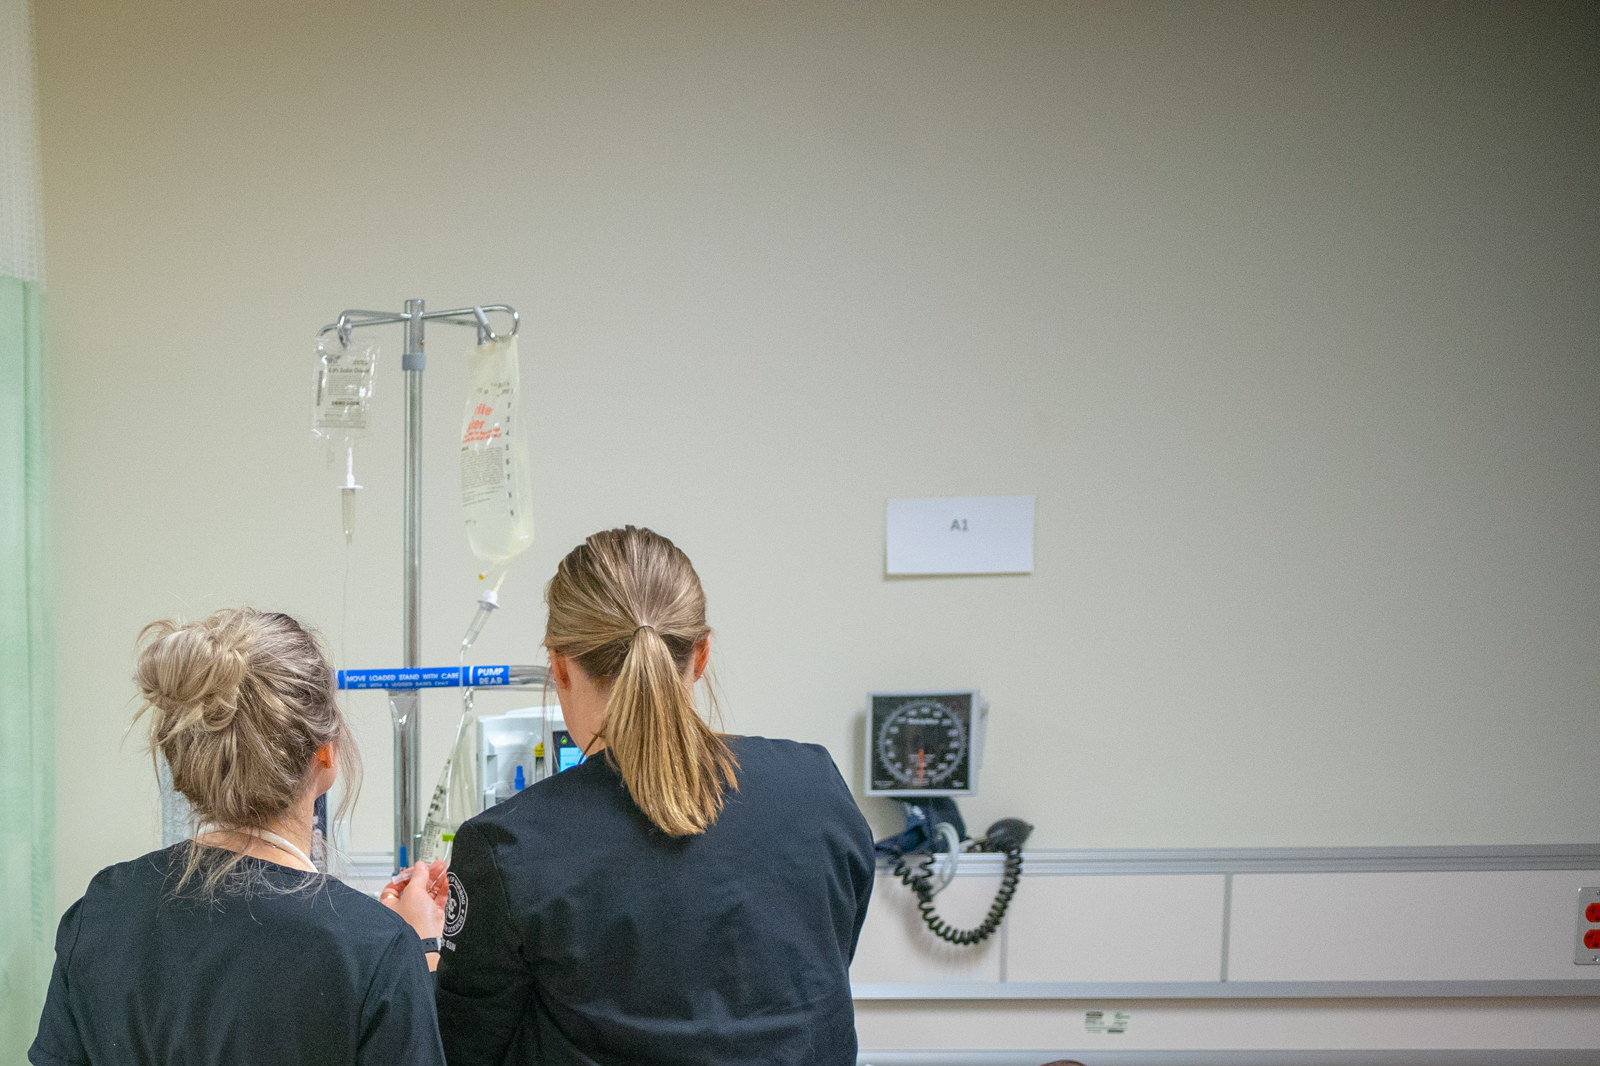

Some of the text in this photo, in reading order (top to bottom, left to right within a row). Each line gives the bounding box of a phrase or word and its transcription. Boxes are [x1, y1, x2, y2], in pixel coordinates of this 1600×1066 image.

[950, 518, 969, 531] A1
[346, 671, 459, 683] MOVE LOADED STAND WITH CARE
[477, 667, 504, 677] PUMP
